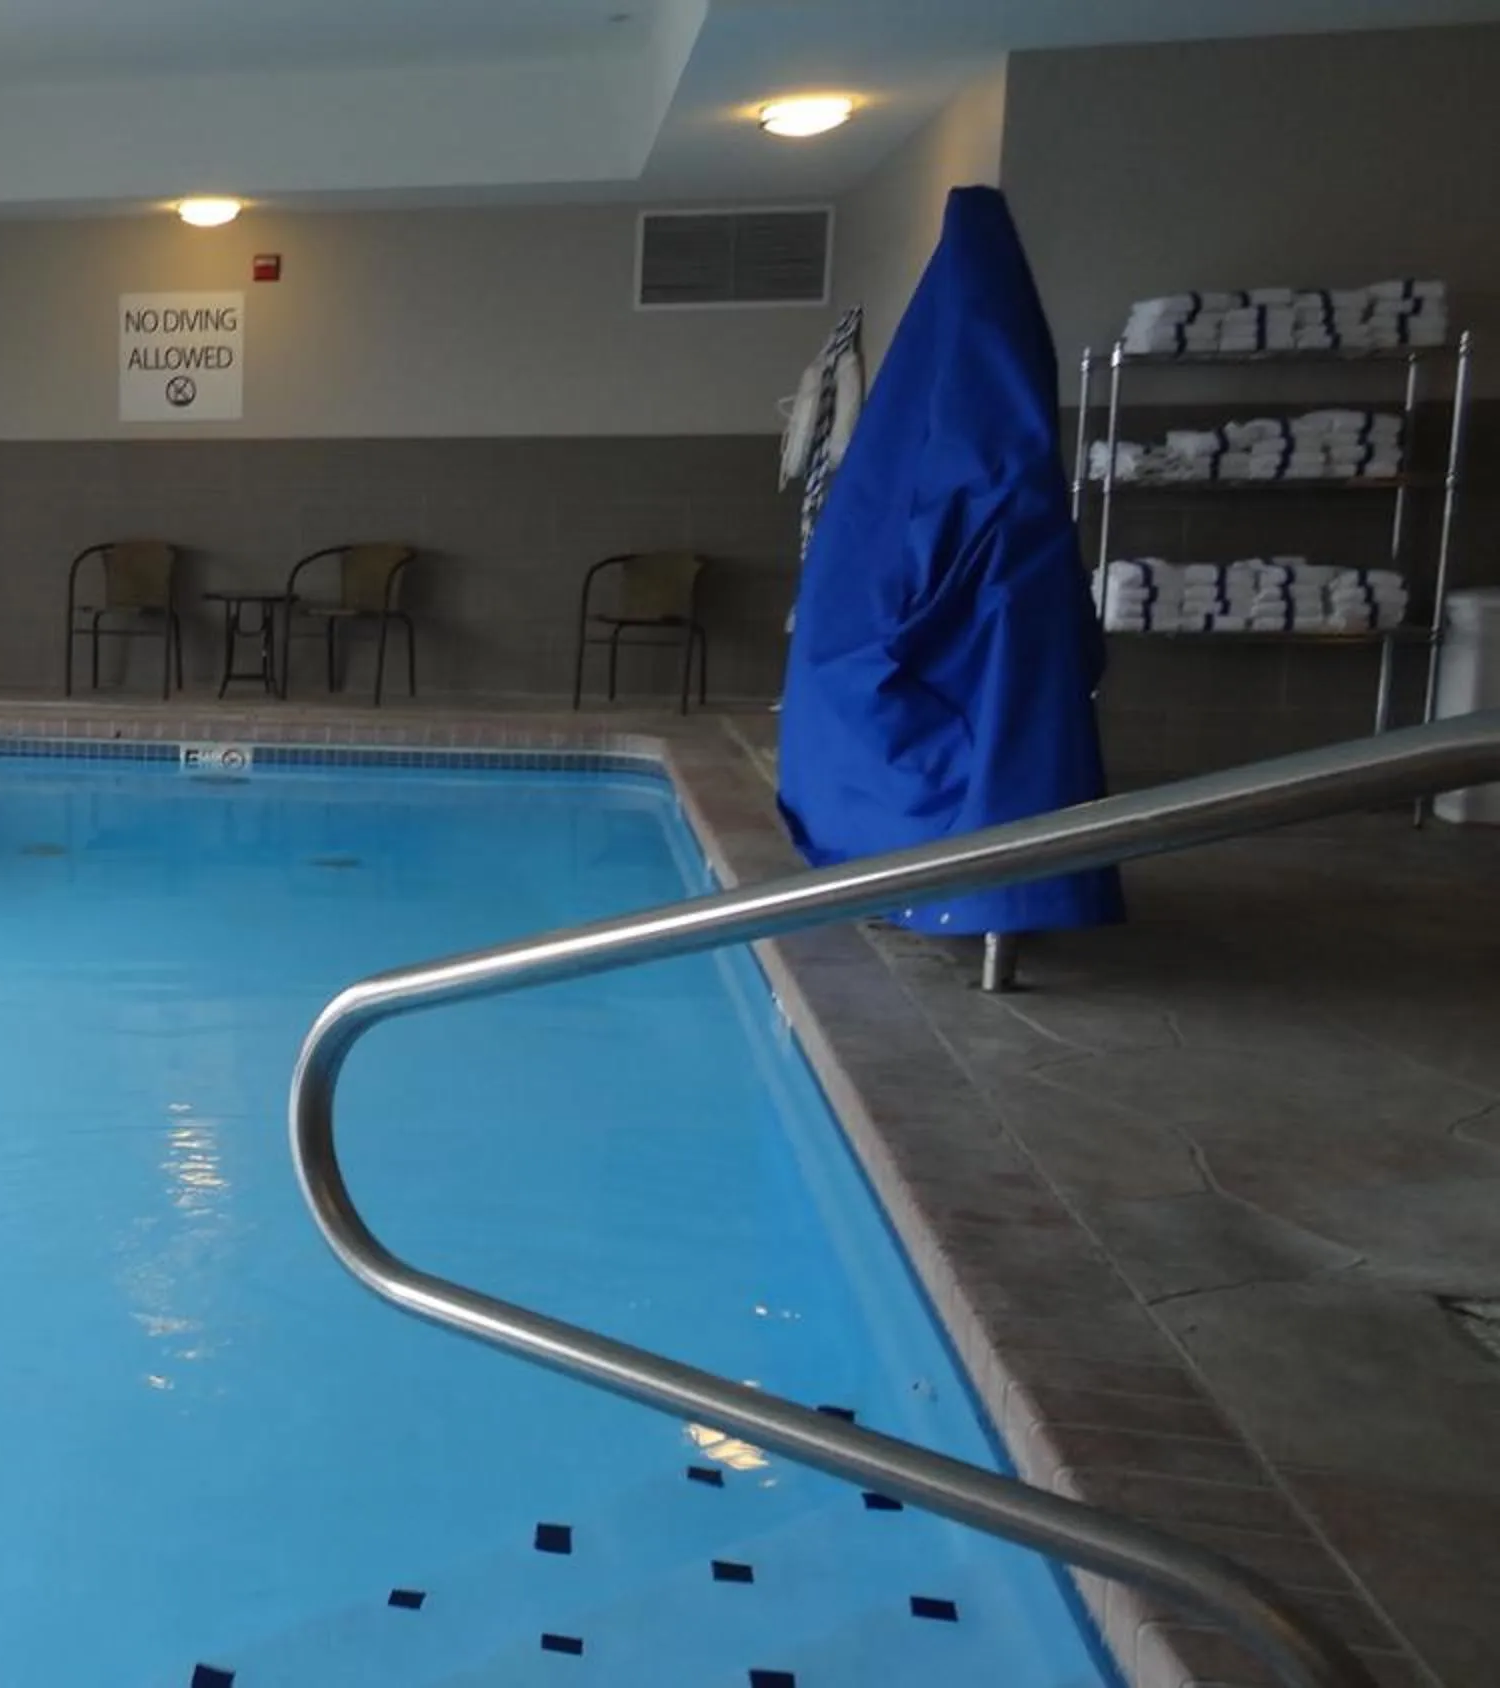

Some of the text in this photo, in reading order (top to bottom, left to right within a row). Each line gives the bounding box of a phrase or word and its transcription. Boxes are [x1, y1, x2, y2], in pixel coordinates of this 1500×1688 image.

[125, 308, 237, 333] NO DIVING
[128, 346, 233, 370] ALLOWED
